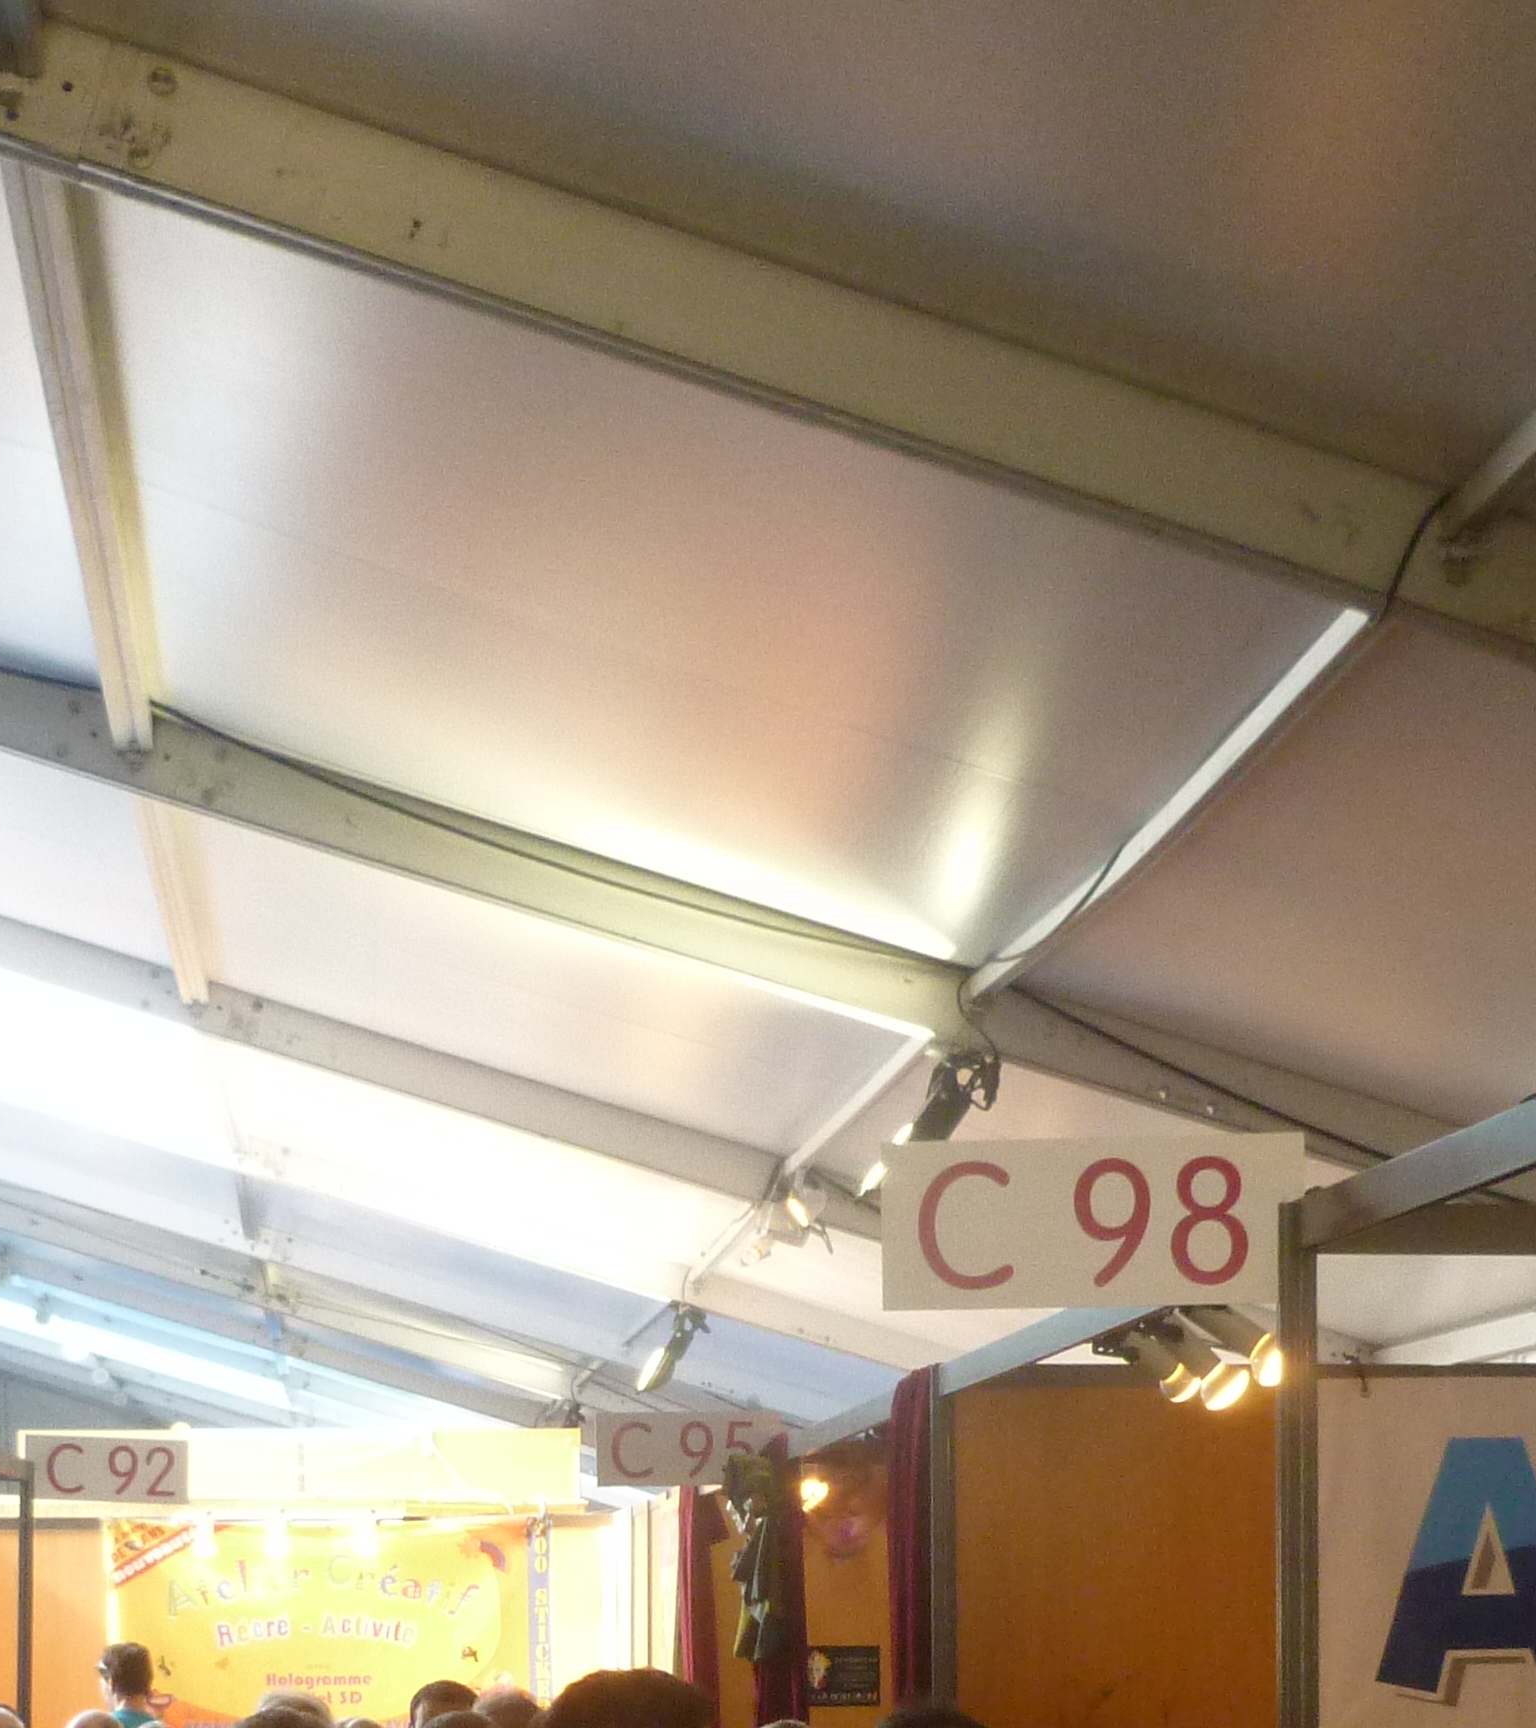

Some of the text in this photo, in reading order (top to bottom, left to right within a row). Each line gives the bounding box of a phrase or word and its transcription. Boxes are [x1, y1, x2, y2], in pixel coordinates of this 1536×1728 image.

[917, 1155, 1250, 1291] C 98
[46, 1442, 176, 1497] C 92
[611, 1420, 754, 1480] C 95
[265, 1672, 373, 1690] Hologramme
